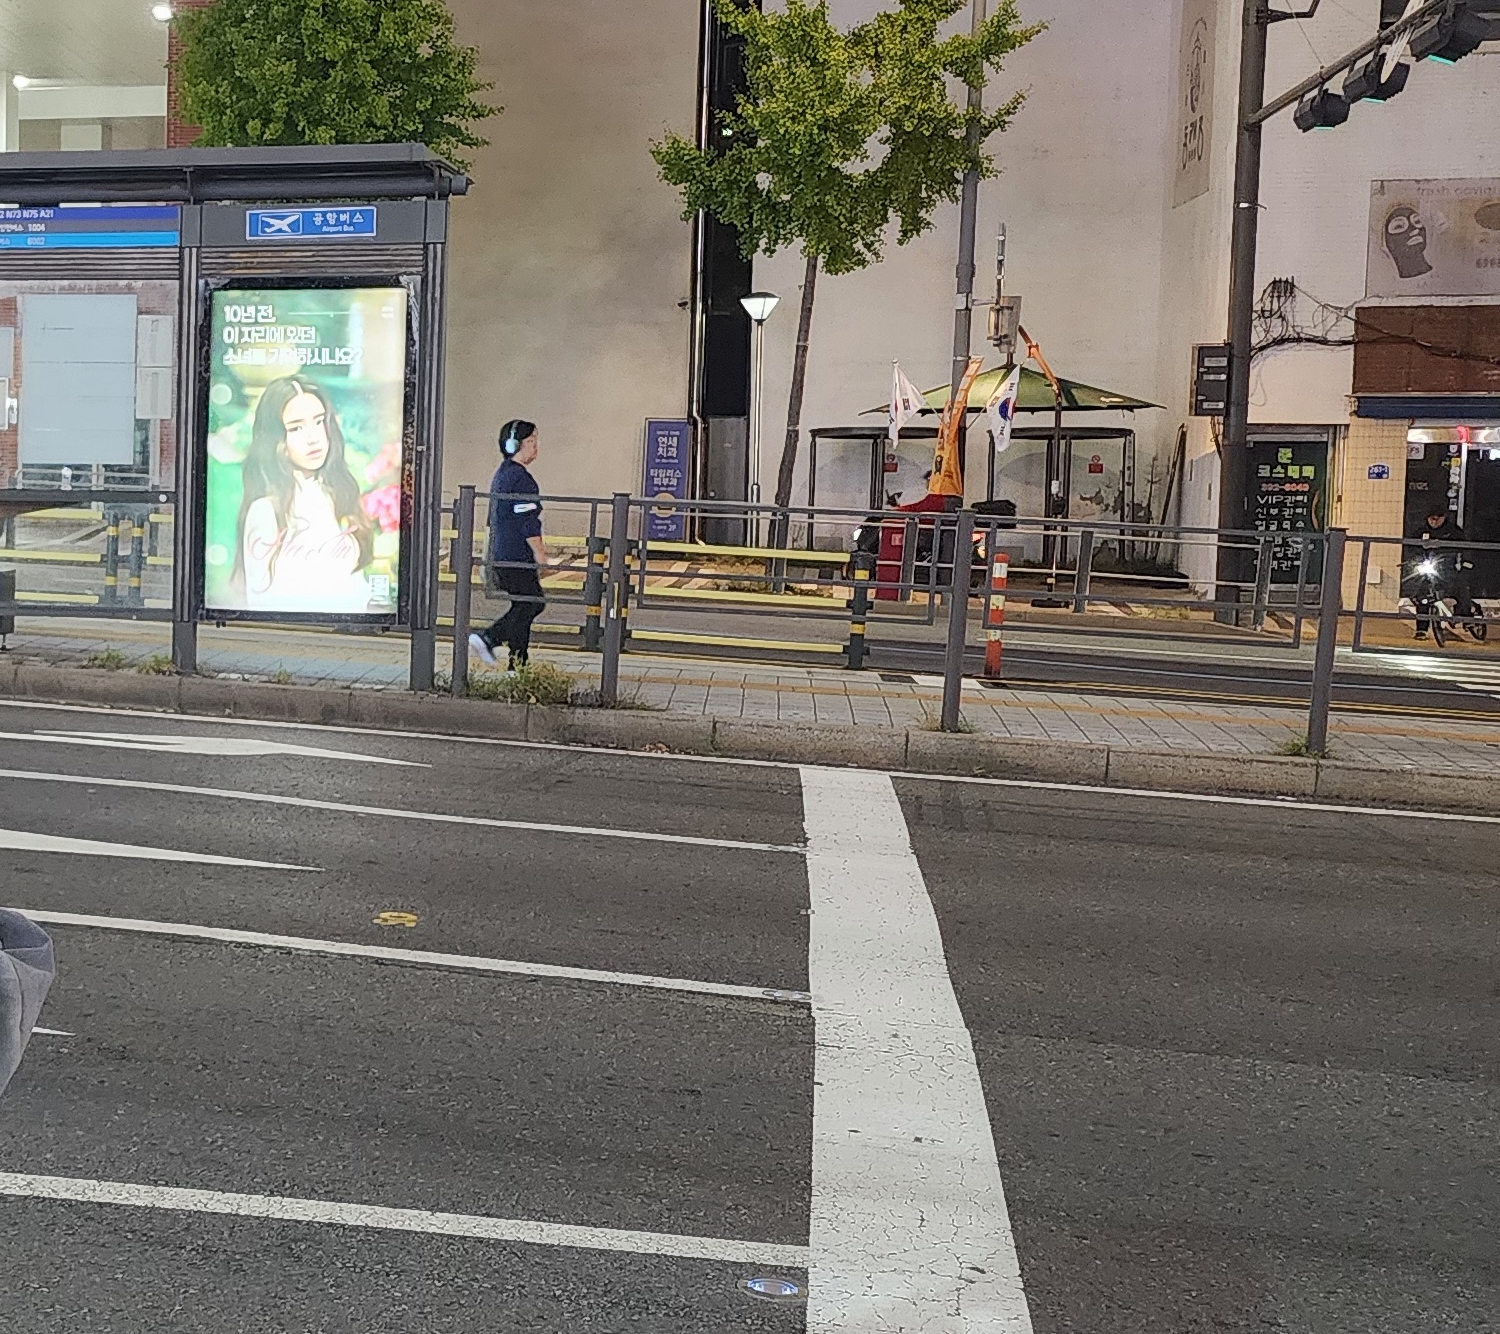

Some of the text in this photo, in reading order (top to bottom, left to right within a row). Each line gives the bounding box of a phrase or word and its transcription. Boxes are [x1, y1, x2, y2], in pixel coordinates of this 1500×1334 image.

[312, 211, 365, 226] 공항버스
[223, 304, 256, 323] 10년
[222, 325, 317, 345] 이 자리에 있던
[657, 436, 678, 447] 연세
[657, 447, 678, 458] 치과
